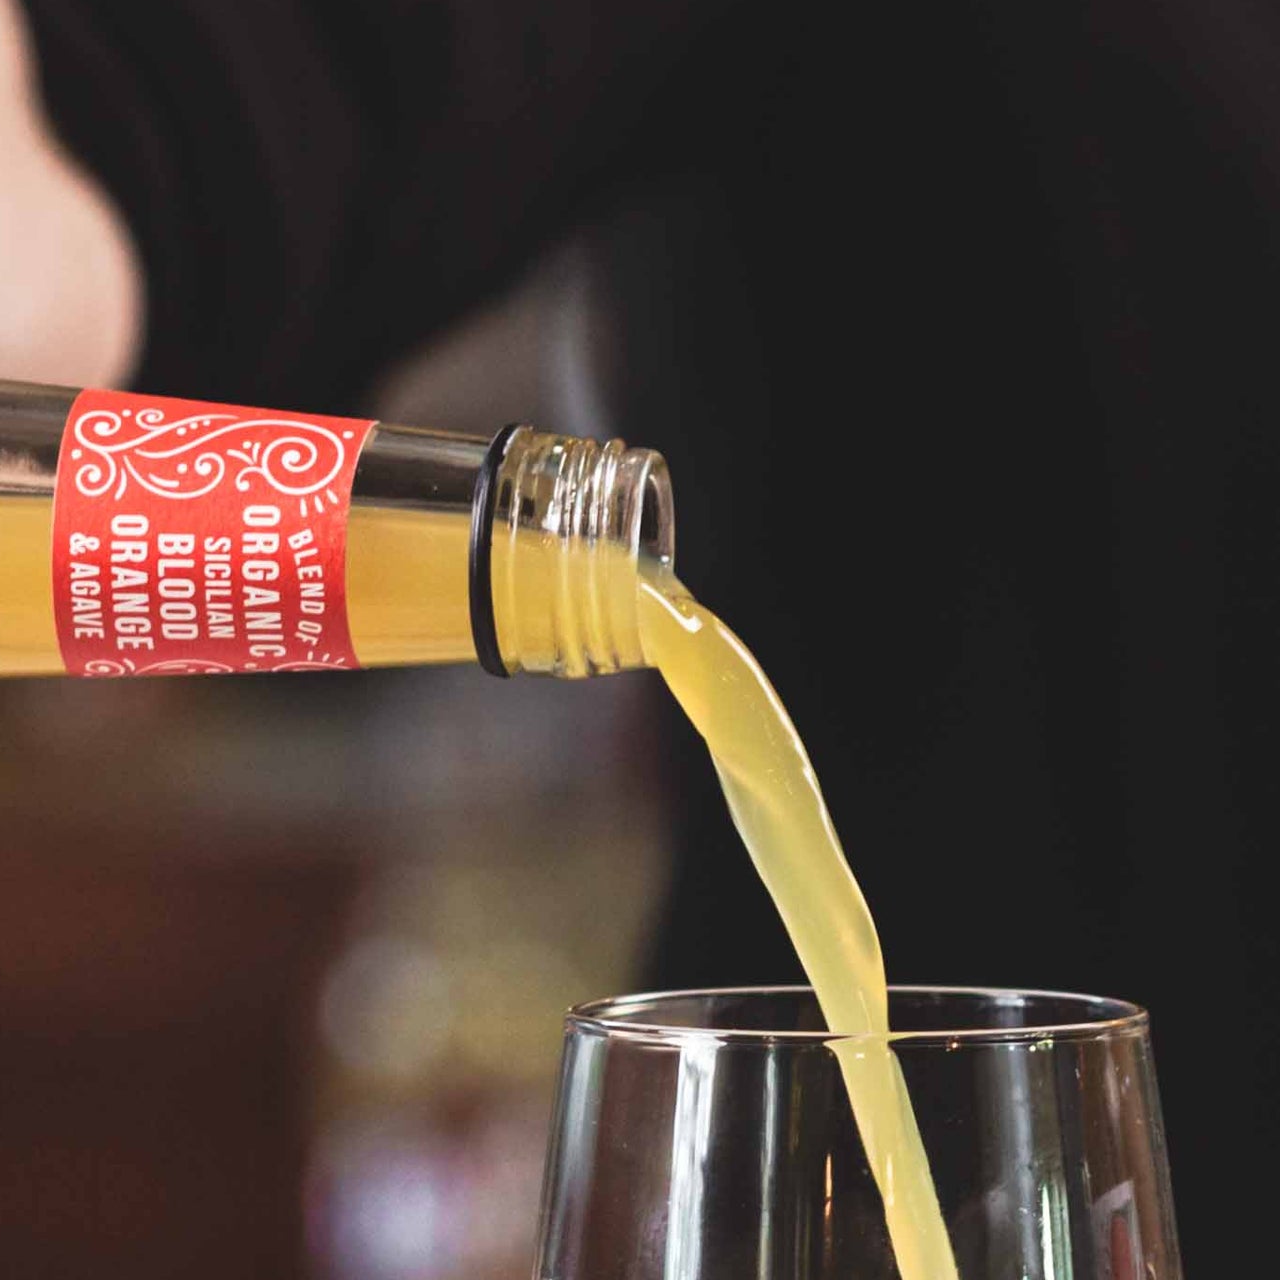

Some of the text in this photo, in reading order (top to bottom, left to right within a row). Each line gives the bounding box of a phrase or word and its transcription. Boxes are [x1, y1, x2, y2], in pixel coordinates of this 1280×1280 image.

[69, 532, 104, 639] & AGAVE
[110, 513, 154, 651] ORANGE
[157, 533, 199, 640] BLOOD
[204, 536, 235, 639] SICILIAN
[242, 505, 287, 657] ORGANIC
[288, 529, 325, 647] BLEND OF
